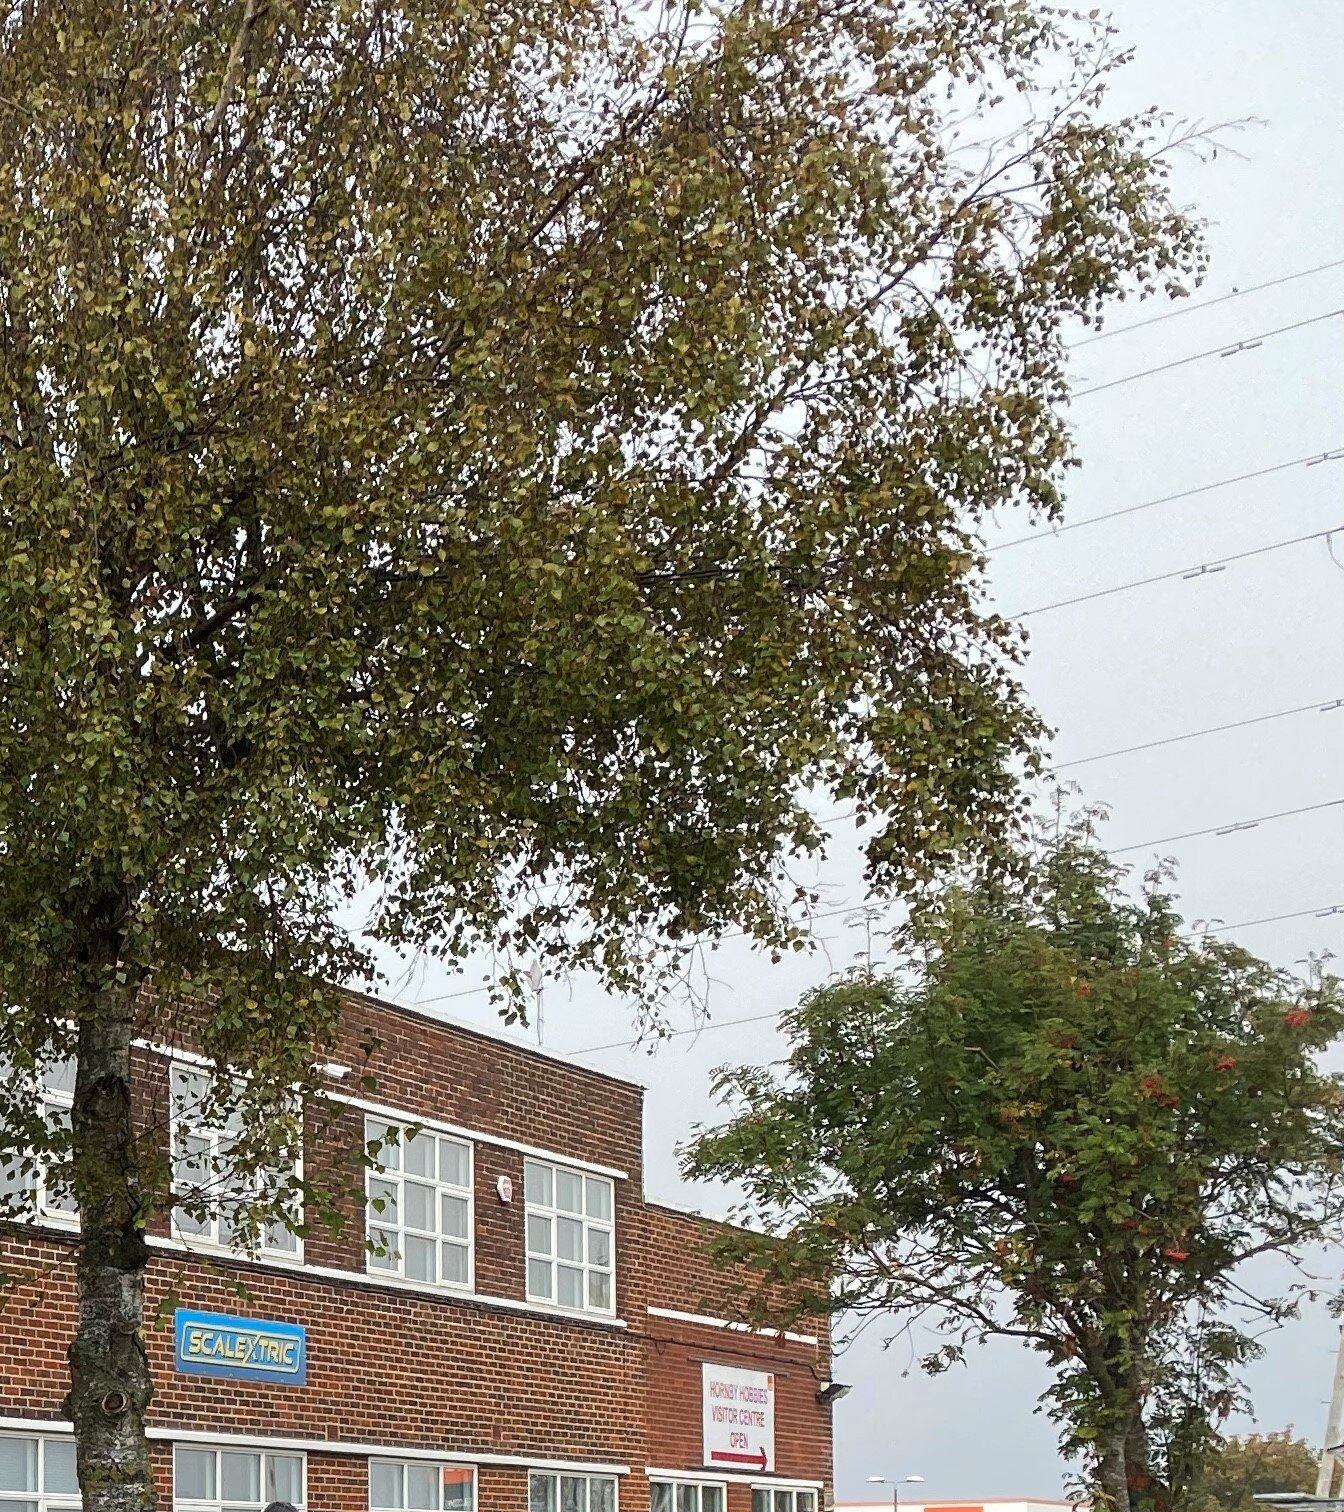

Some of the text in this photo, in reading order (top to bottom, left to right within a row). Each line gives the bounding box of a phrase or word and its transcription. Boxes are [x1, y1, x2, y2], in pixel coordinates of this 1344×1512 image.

[188, 1330, 295, 1366] SCALEXTRIC
[709, 1380, 769, 1405] HORNBY HOBBIES
[711, 1404, 766, 1428] VISITOR CENTRE
[730, 1431, 749, 1449] OPEN
